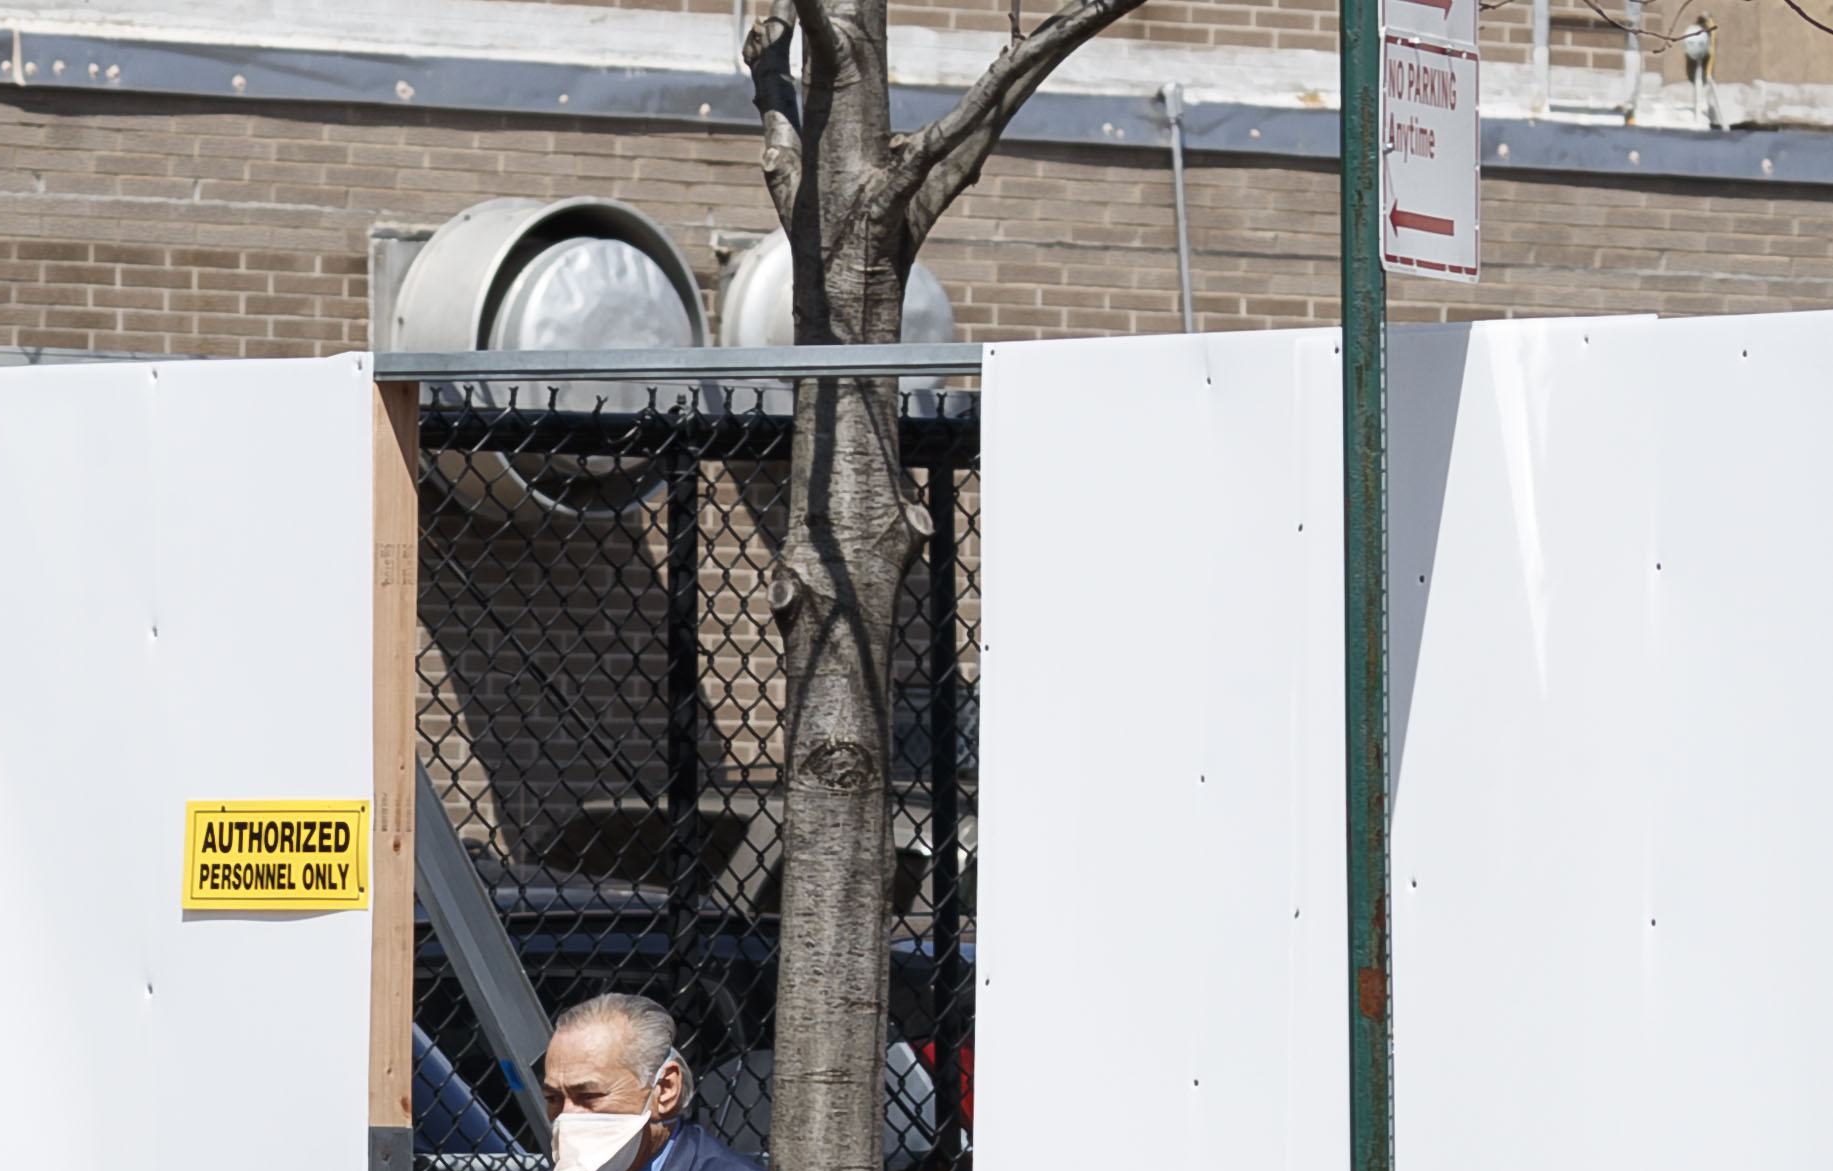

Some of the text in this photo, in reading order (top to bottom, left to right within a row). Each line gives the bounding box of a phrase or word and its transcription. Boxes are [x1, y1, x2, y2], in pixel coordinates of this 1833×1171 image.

[1388, 59, 1457, 110] NO PARKING
[1388, 112, 1435, 163] Anytime
[201, 820, 350, 853] AUTHORIZED
[199, 863, 350, 890] PERSONNEL ONLY
